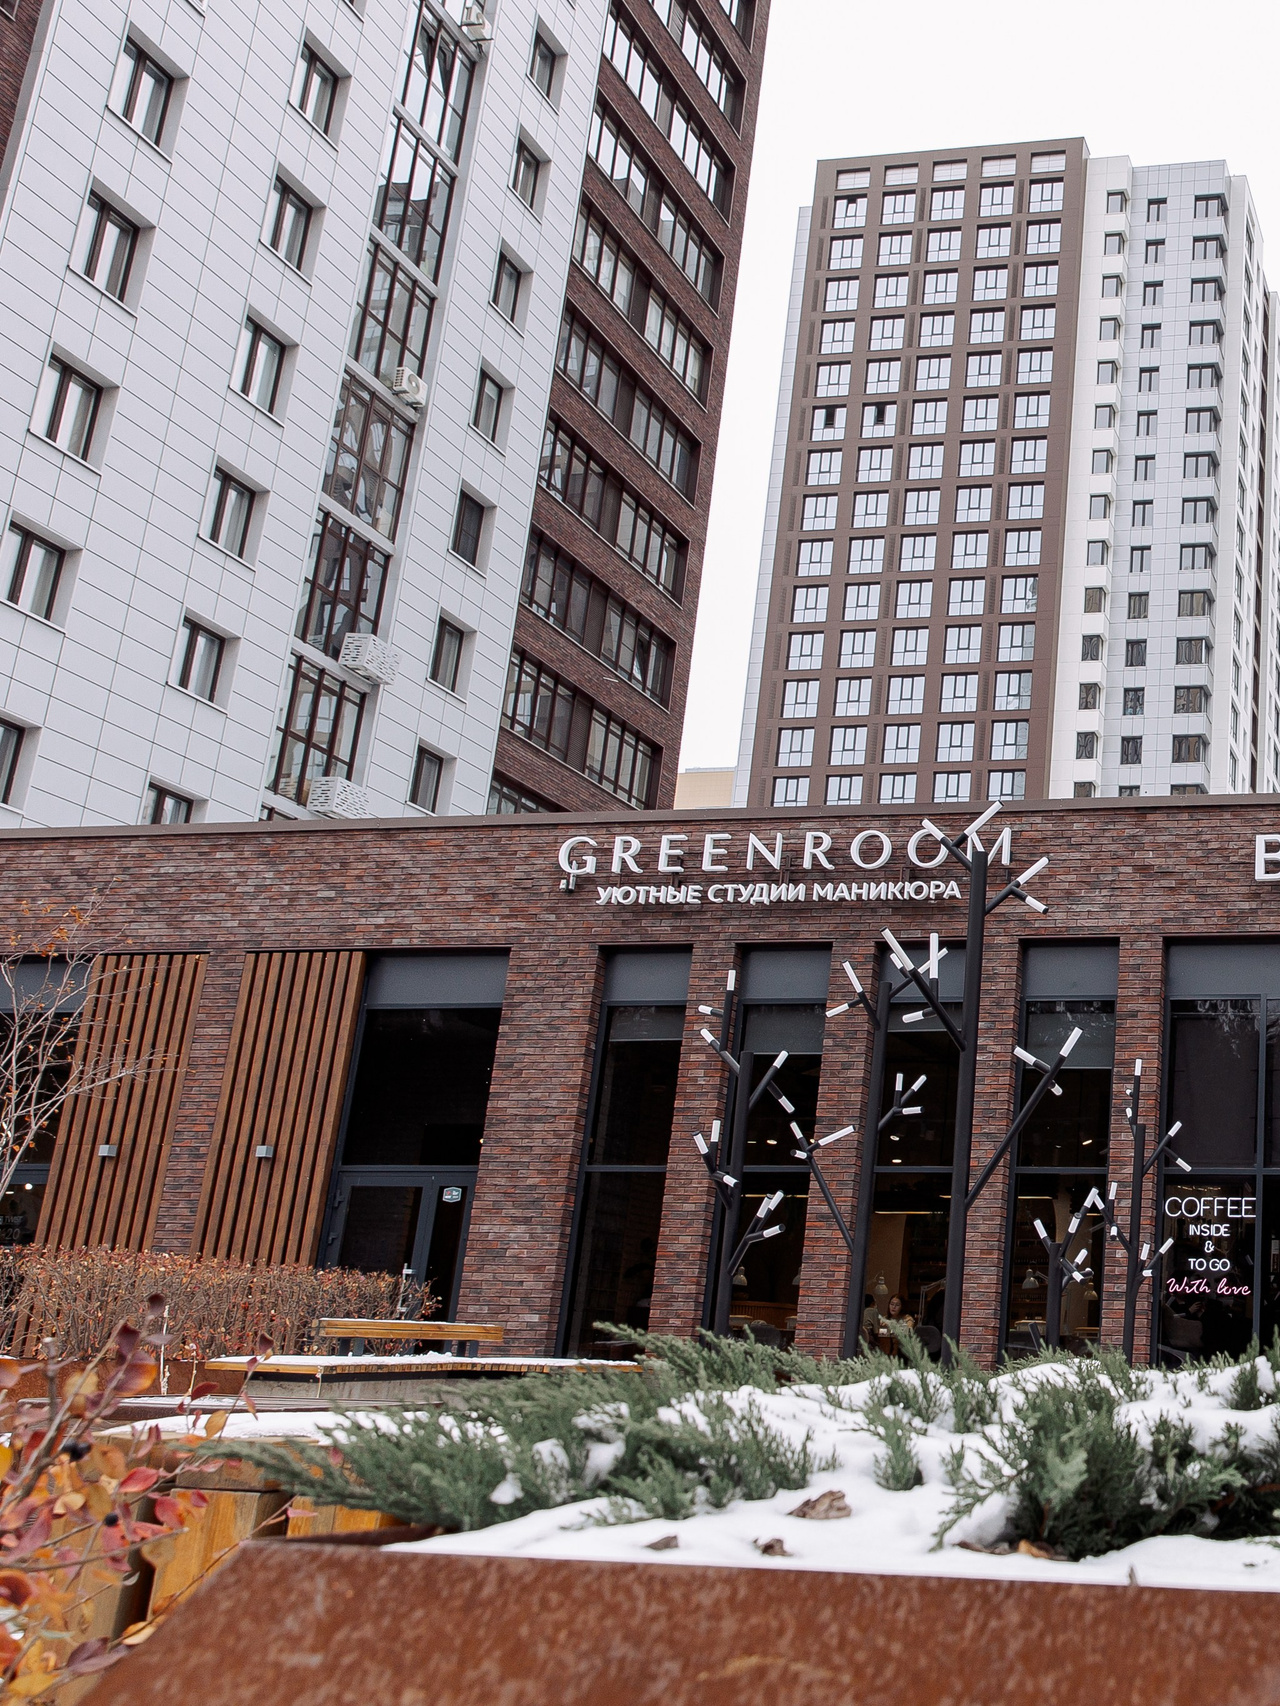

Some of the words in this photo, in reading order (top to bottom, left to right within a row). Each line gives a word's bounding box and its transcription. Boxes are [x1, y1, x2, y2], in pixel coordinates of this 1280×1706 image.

[558, 827, 1011, 875] GREENROOM
[596, 886, 702, 905] УЮТНЫЕ
[708, 883, 806, 905] СТУДИИ
[812, 880, 962, 904] МАНИКЮРА
[1164, 1196, 1257, 1218] COFFEE
[1189, 1223, 1231, 1237] INSIDE
[1204, 1240, 1215, 1253] &
[1188, 1258, 1206, 1271] TO
[1209, 1258, 1231, 1272] GO
[1166, 1276, 1211, 1294] With
[1216, 1277, 1251, 1295] love
